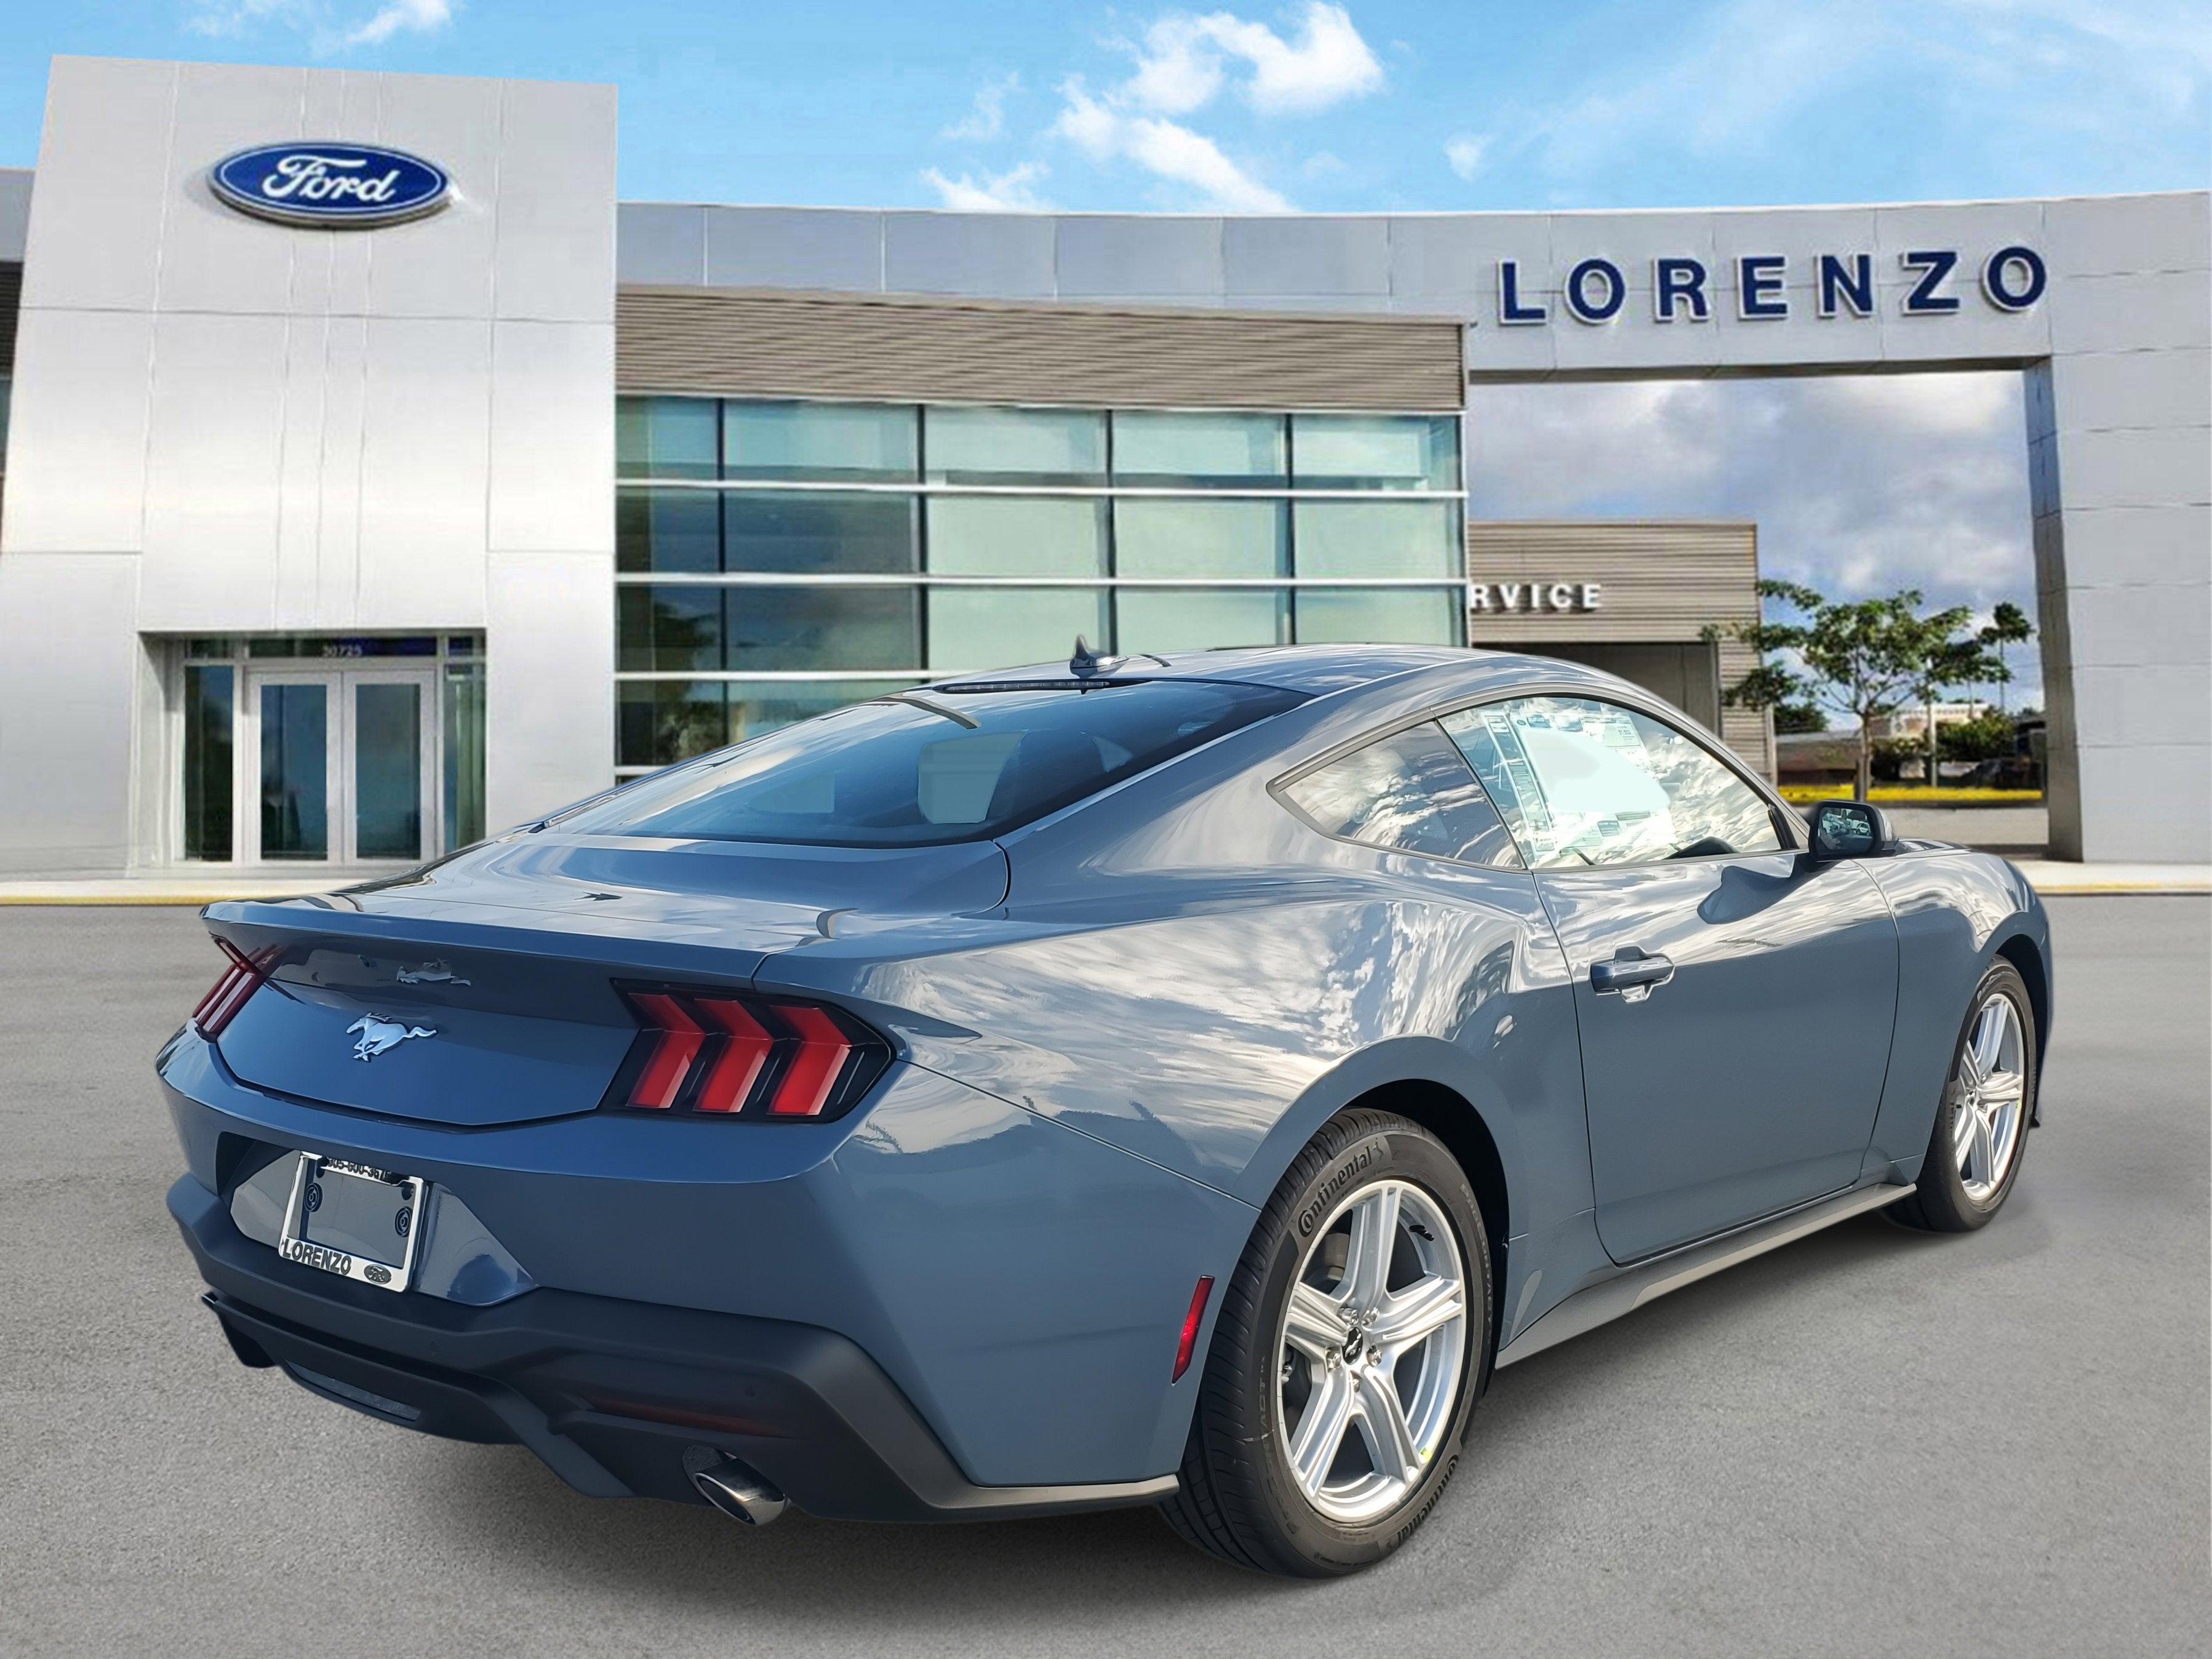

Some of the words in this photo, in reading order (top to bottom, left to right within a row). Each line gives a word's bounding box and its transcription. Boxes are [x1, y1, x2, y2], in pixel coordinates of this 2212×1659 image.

[262, 154, 401, 202] Ford
[1497, 246, 2048, 324] LORENZO
[1298, 1146, 1373, 1238] Continental
[282, 1239, 352, 1276] LORENZO
